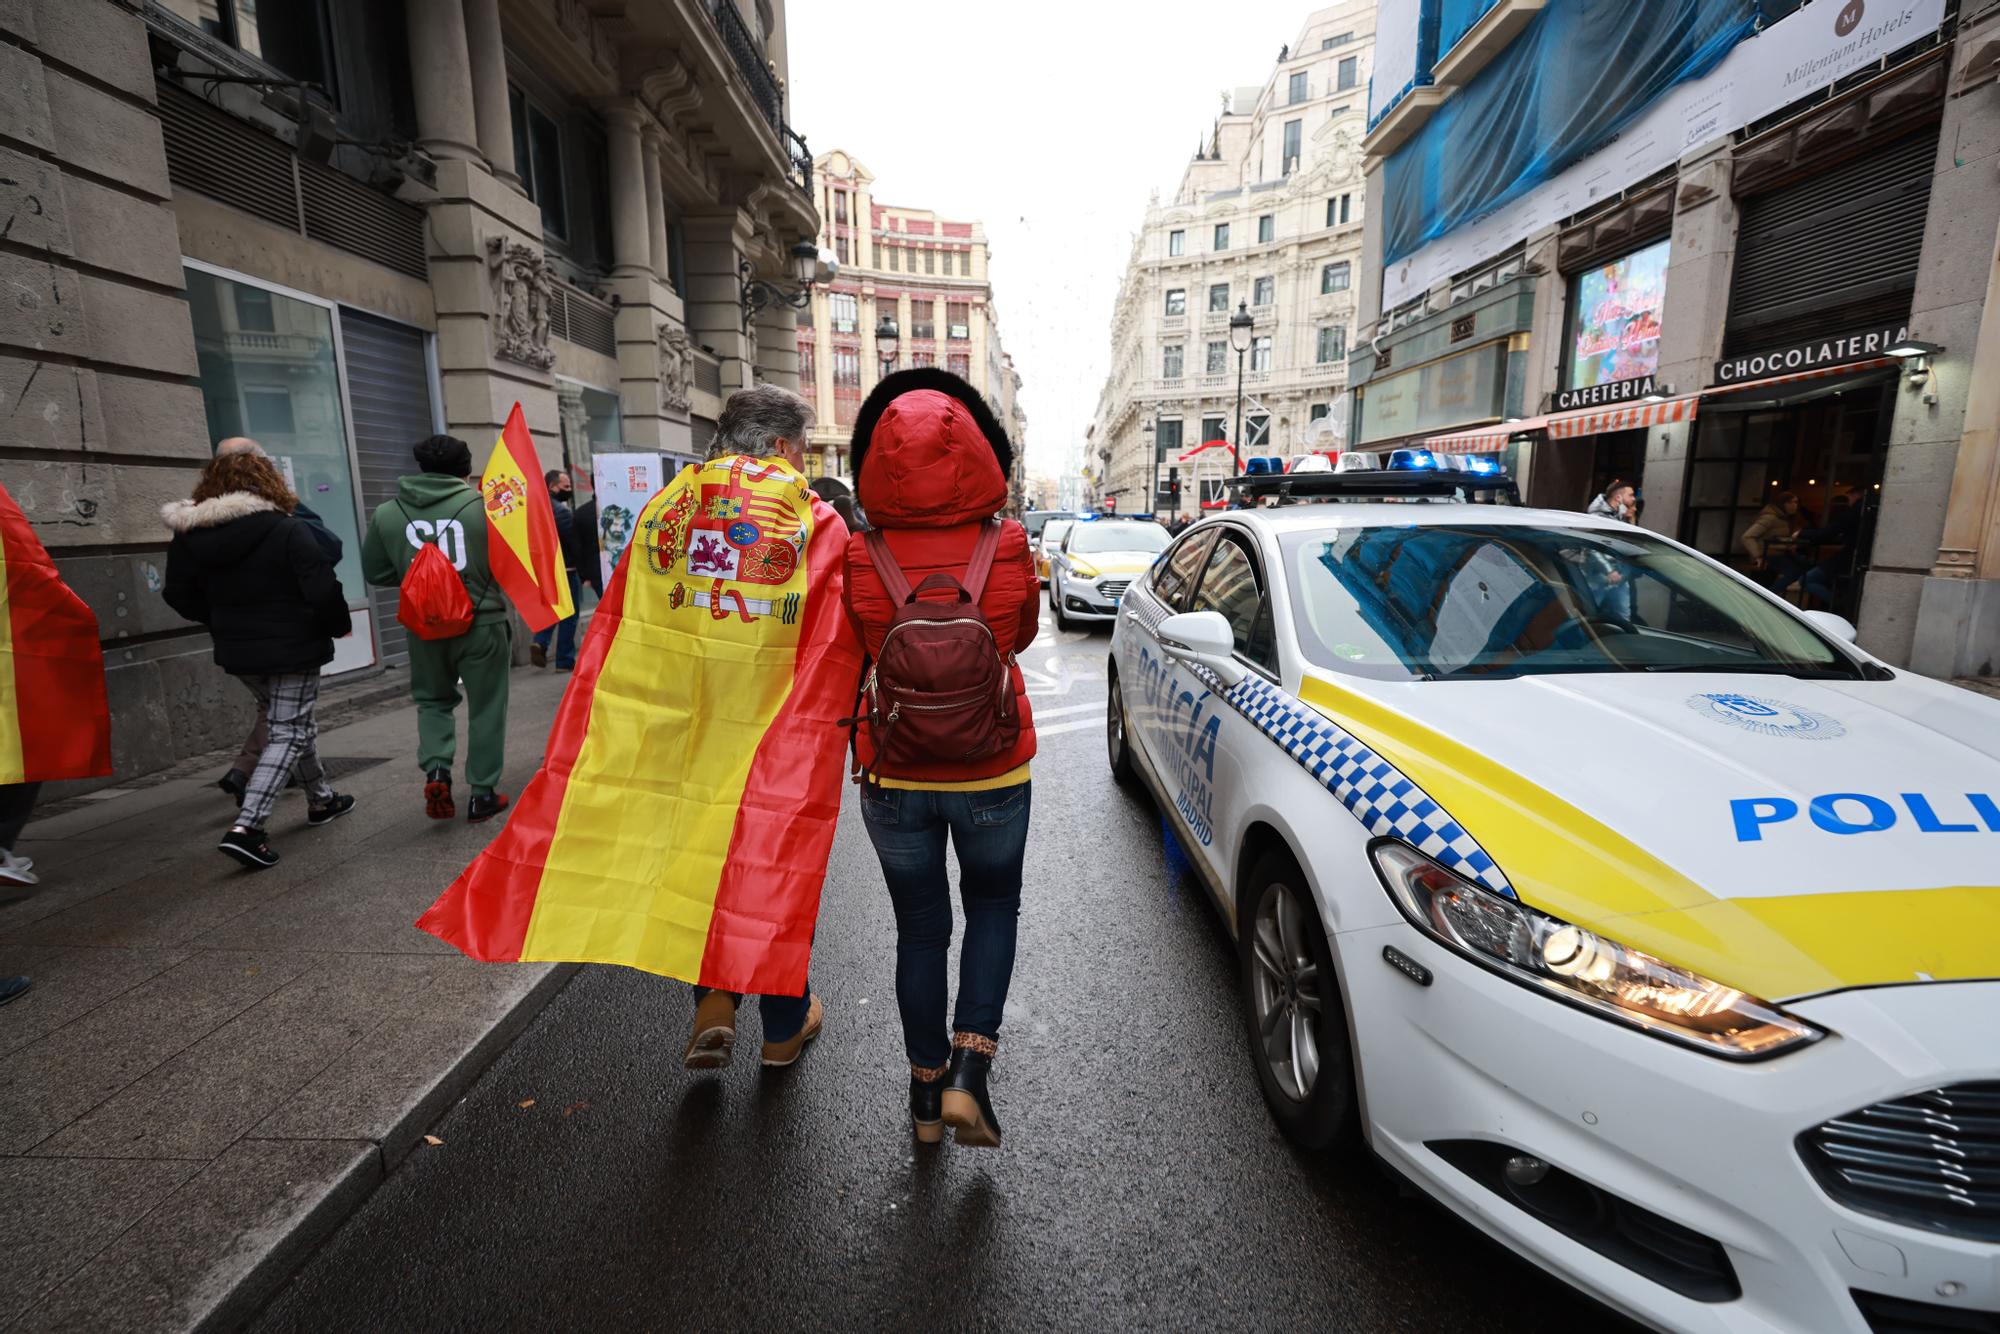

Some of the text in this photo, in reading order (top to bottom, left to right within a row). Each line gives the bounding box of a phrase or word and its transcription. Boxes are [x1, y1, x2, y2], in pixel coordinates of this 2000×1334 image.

[1842, 9, 1857, 27] M
[1783, 9, 1913, 88] Millenium Hotels
[1720, 326, 1907, 380] CHOCOLATERIA
[1559, 378, 1653, 408] CAFETERIA
[1136, 646, 1221, 785] POLICÍA
[1157, 727, 1214, 826] MUNICIPAL
[1175, 788, 1213, 847] MADRID
